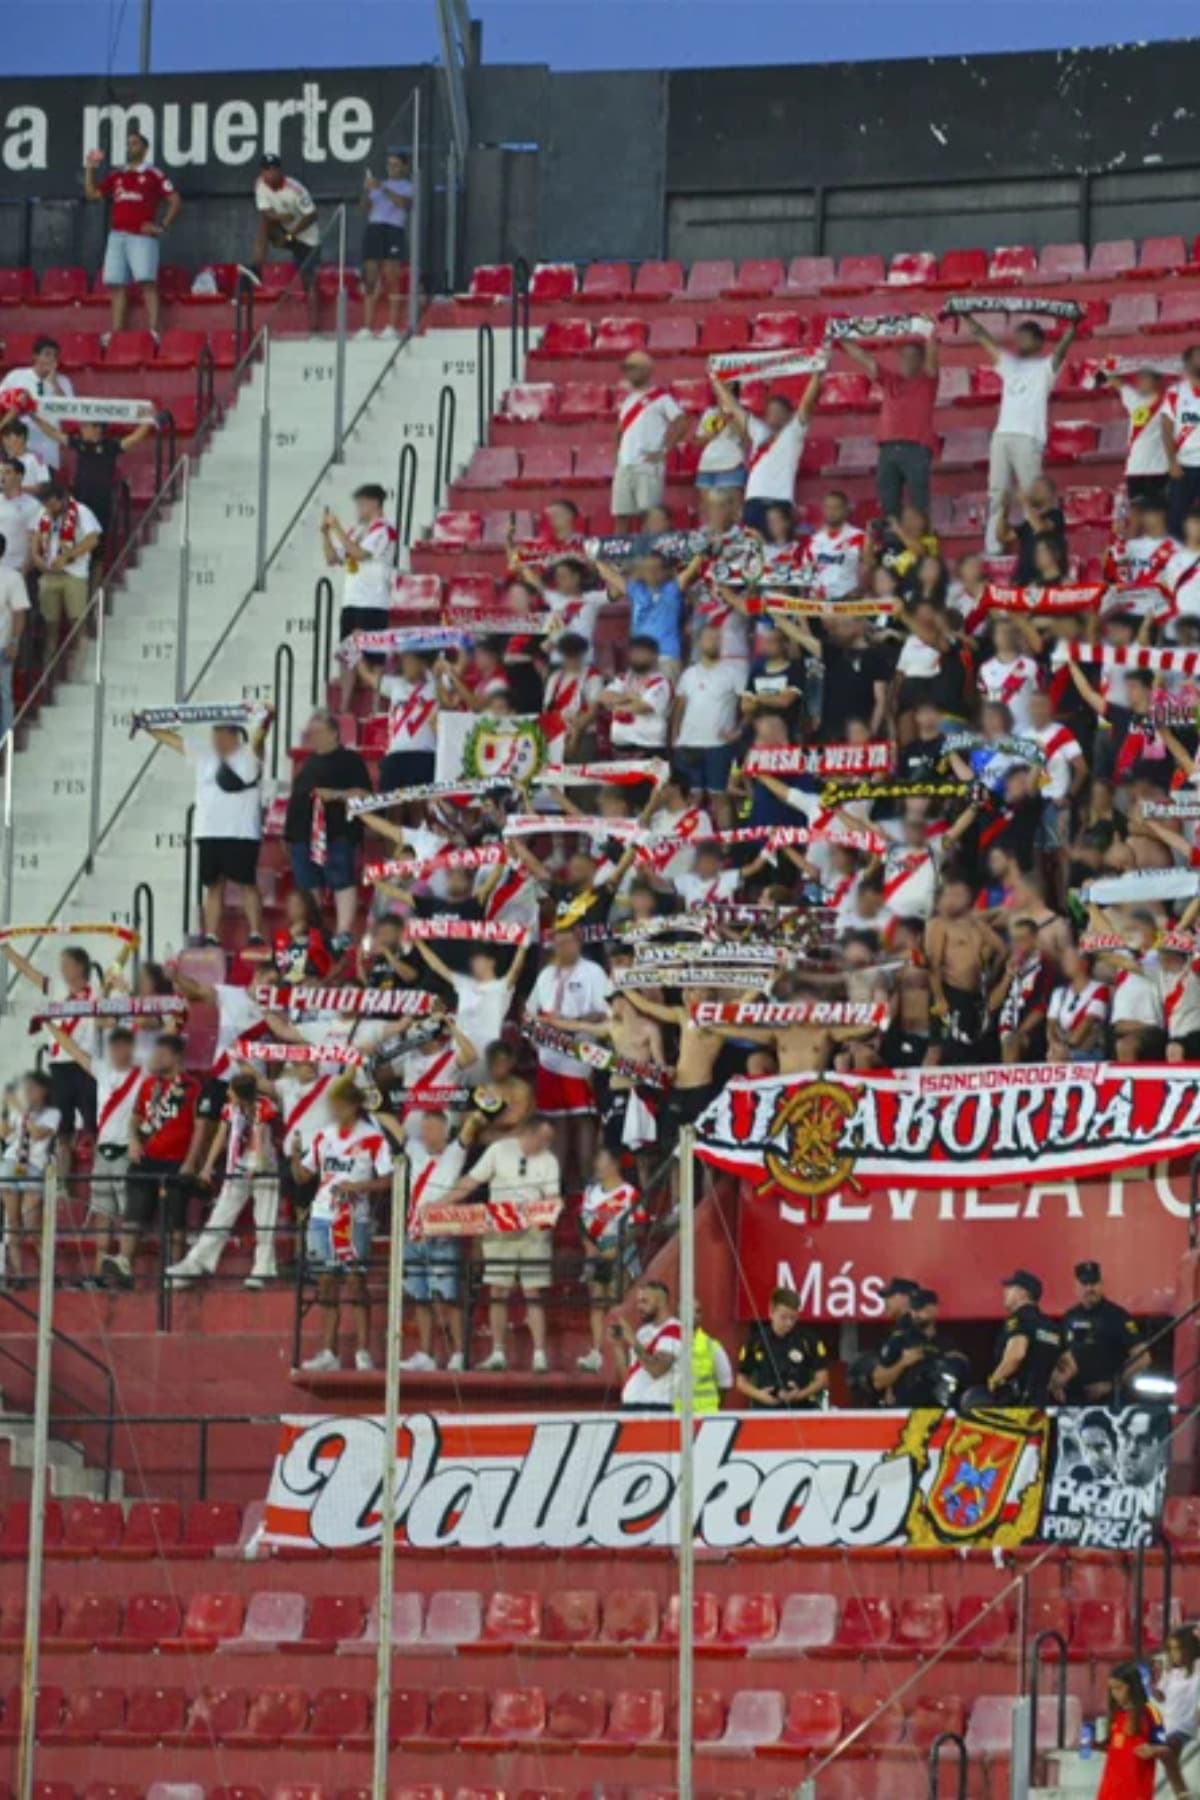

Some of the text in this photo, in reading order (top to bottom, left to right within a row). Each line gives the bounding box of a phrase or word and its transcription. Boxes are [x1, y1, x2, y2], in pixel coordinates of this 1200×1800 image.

[2, 83, 374, 170] a muerte
[777, 1261, 887, 1318] Más
[279, 1413, 916, 1548] Vallekas
